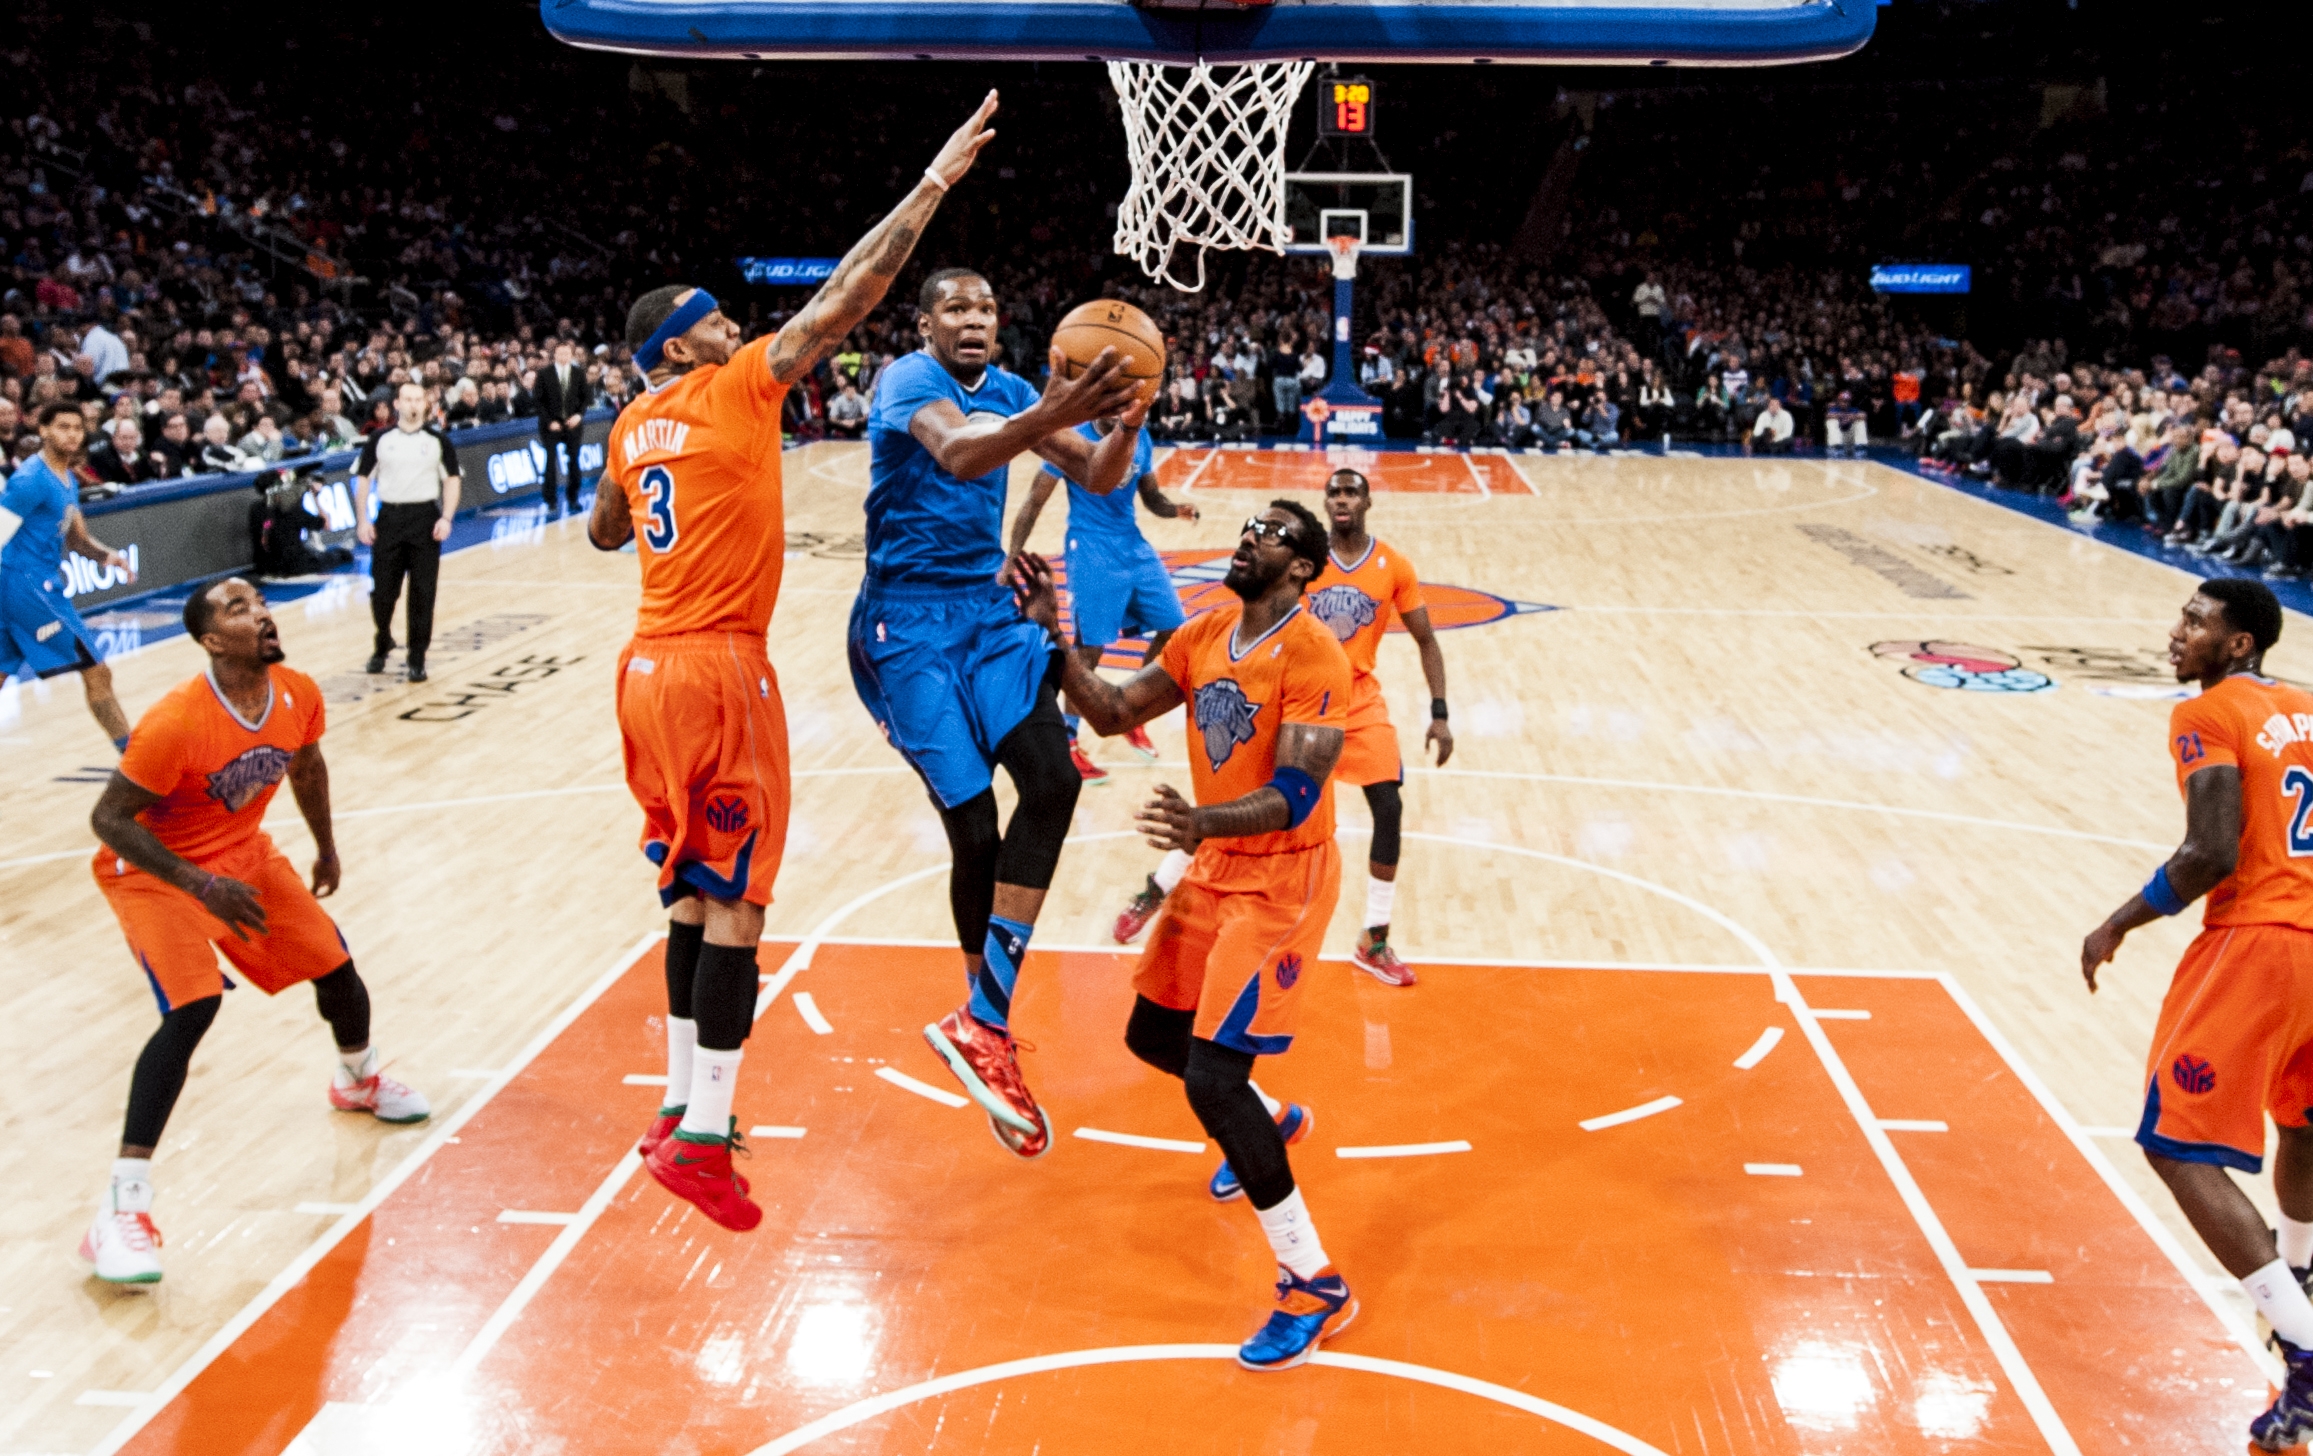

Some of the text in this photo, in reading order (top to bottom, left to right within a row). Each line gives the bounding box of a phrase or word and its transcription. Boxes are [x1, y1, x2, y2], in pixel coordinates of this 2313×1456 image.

[1334, 84, 1369, 104] 3:20
[1337, 103, 1366, 132] 13
[795, 263, 835, 278] LIG
[1911, 271, 1962, 285] LIGHT
[1326, 421, 1378, 434] HOLIDAYS
[1335, 410, 1372, 422] HAPPY
[623, 417, 690, 464] MARTIN
[638, 463, 679, 554] 3
[396, 653, 587, 721] CHASE
[2176, 731, 2206, 764] 21
